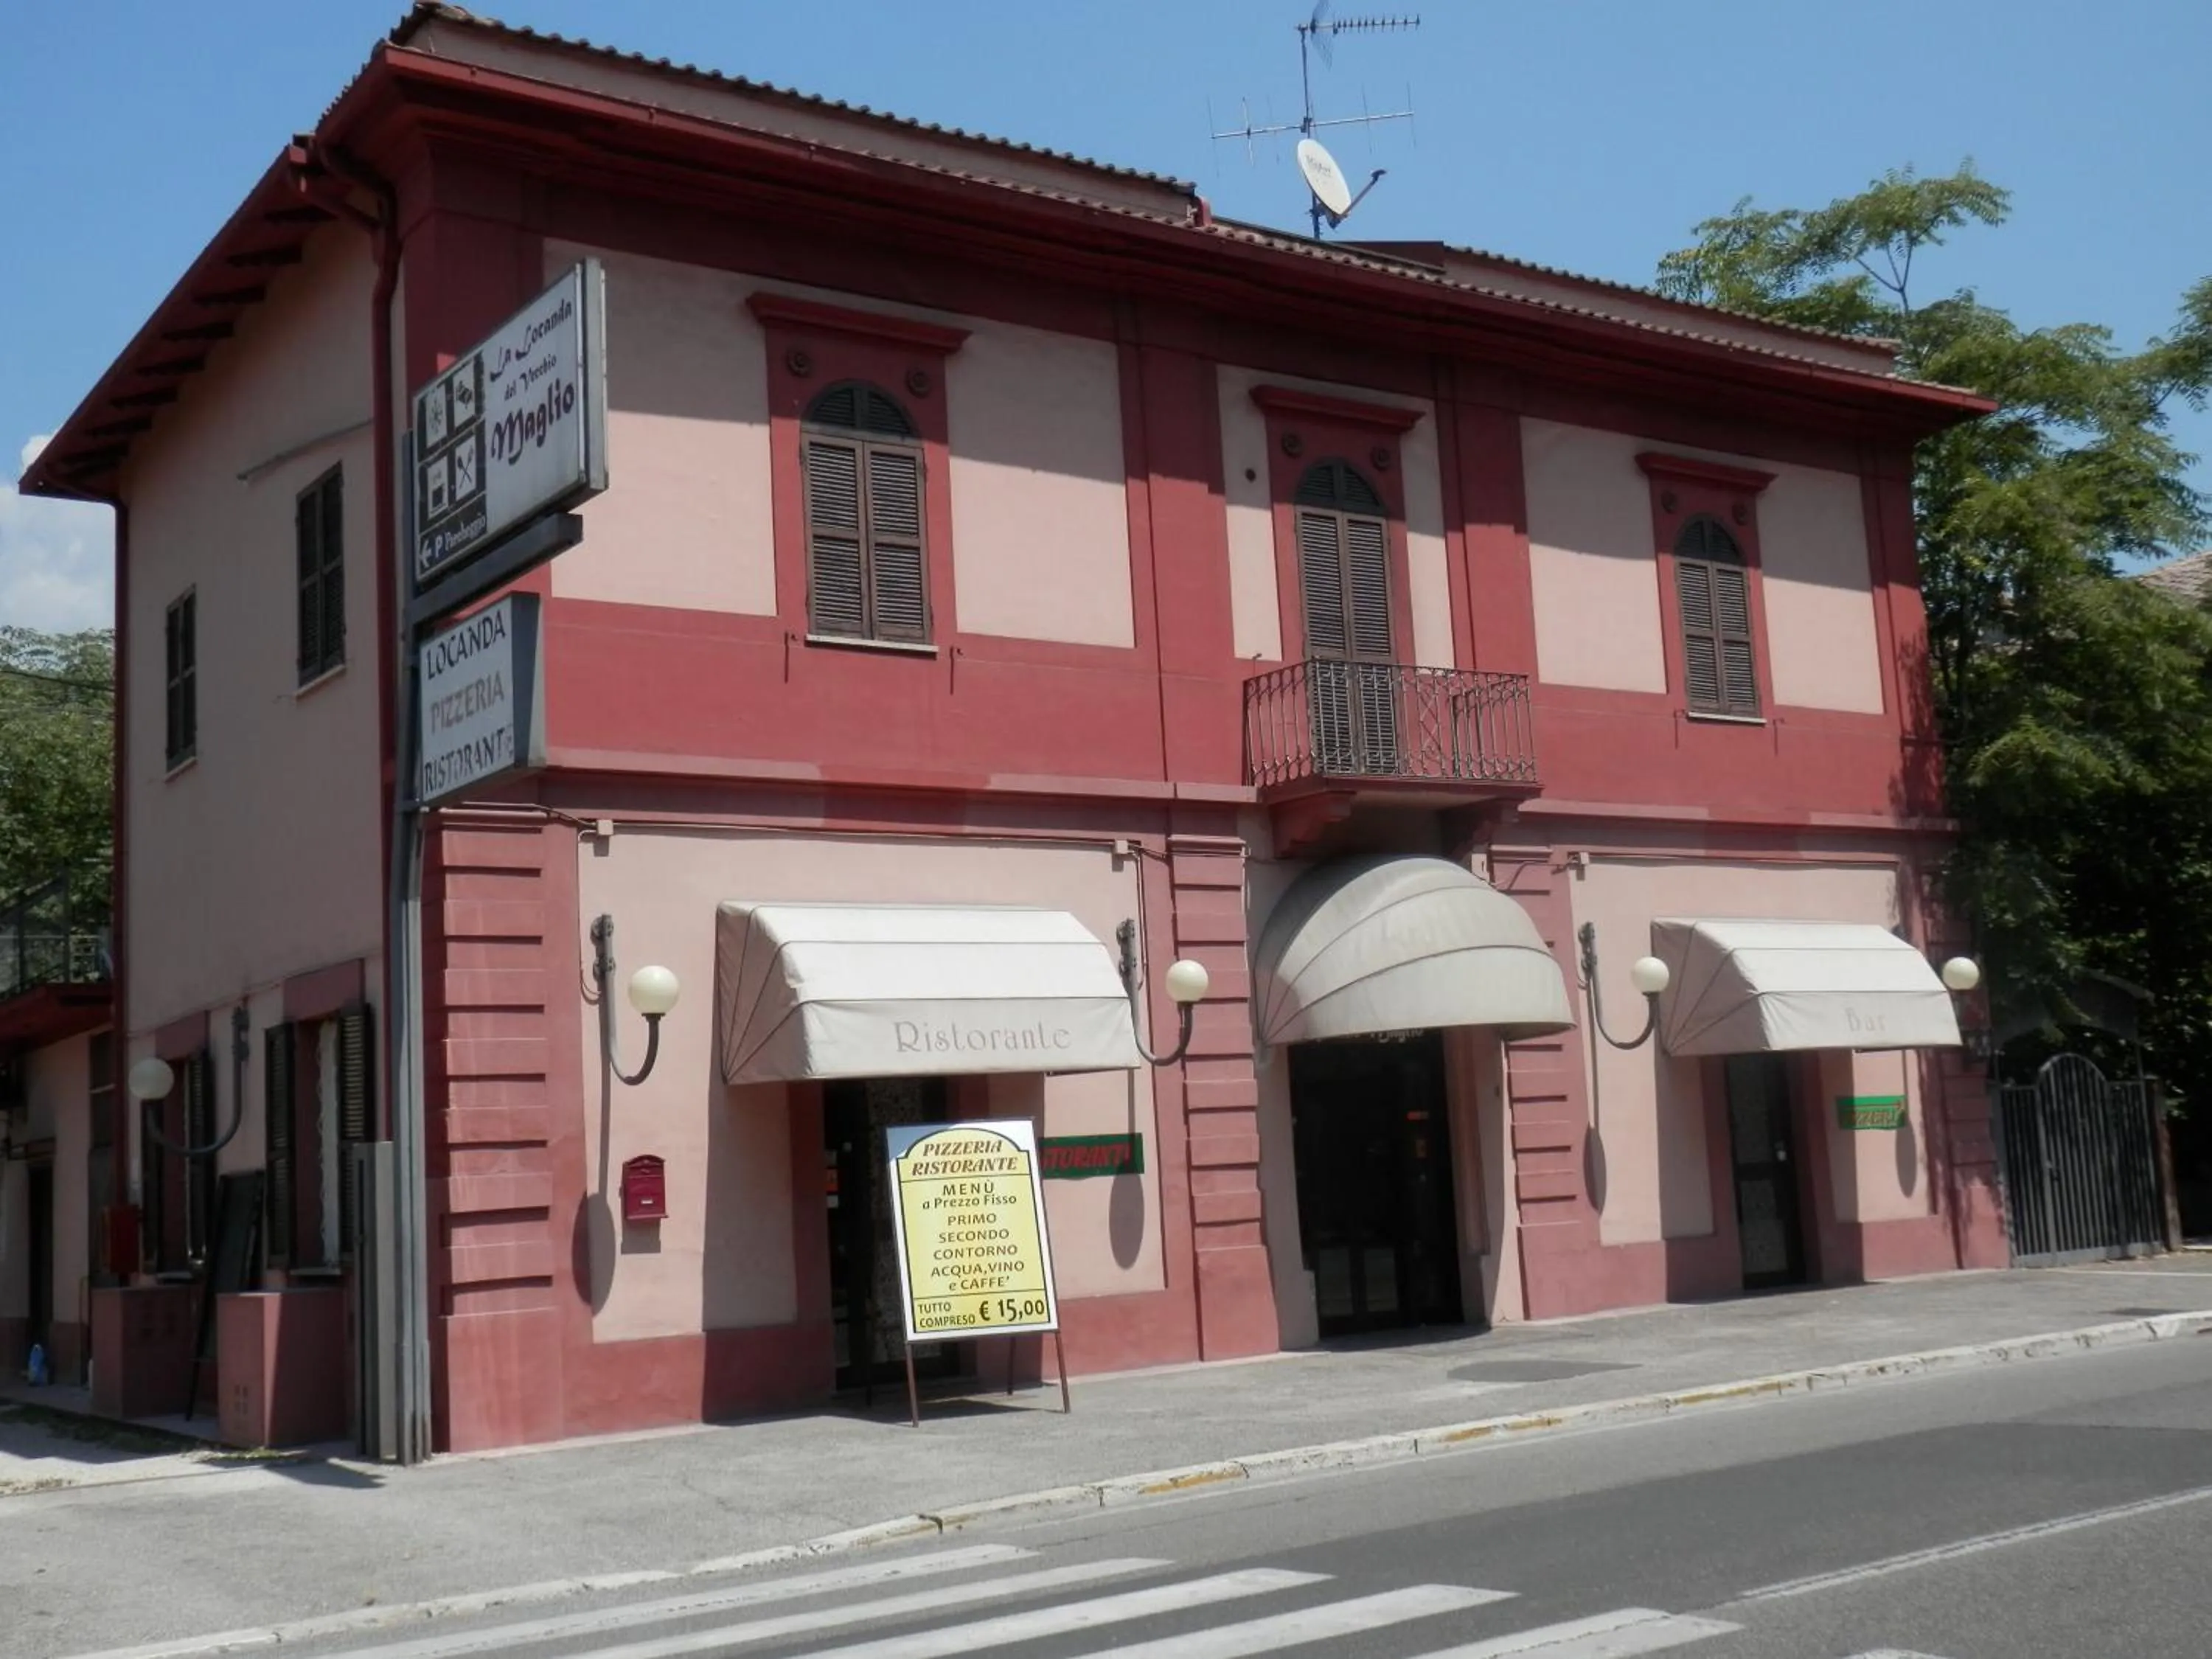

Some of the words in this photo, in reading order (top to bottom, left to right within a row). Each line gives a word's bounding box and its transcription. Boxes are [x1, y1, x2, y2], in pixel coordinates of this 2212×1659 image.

[490, 346, 512, 382] La
[515, 298, 572, 361] Locanda
[504, 378, 517, 400] del
[520, 353, 557, 391] Vecchio
[491, 378, 575, 466] Maglio
[427, 610, 506, 680] LOCANDA
[431, 670, 504, 734] PIZZERIA
[1845, 1007, 1886, 1032] Bar
[893, 1020, 1071, 1053] Ristorante
[922, 1140, 1002, 1156] PIZZERIA
[911, 1156, 1018, 1176] RISTORANTE
[942, 1179, 995, 1195] MENÙ
[922, 1200, 930, 1210] a
[933, 1196, 980, 1208] Prezzo
[984, 1194, 1017, 1206] Fisso
[947, 1213, 997, 1226] PRIMO
[938, 1228, 1009, 1243] SECONDO
[933, 1244, 1018, 1261] CONTORNO
[949, 1282, 956, 1291] e
[961, 1276, 1010, 1290] CAFFE'
[918, 1303, 952, 1314] TUTTO
[978, 1301, 991, 1322] €
[997, 1298, 1046, 1322] 15,00
[919, 1314, 975, 1328] COMPRESO
